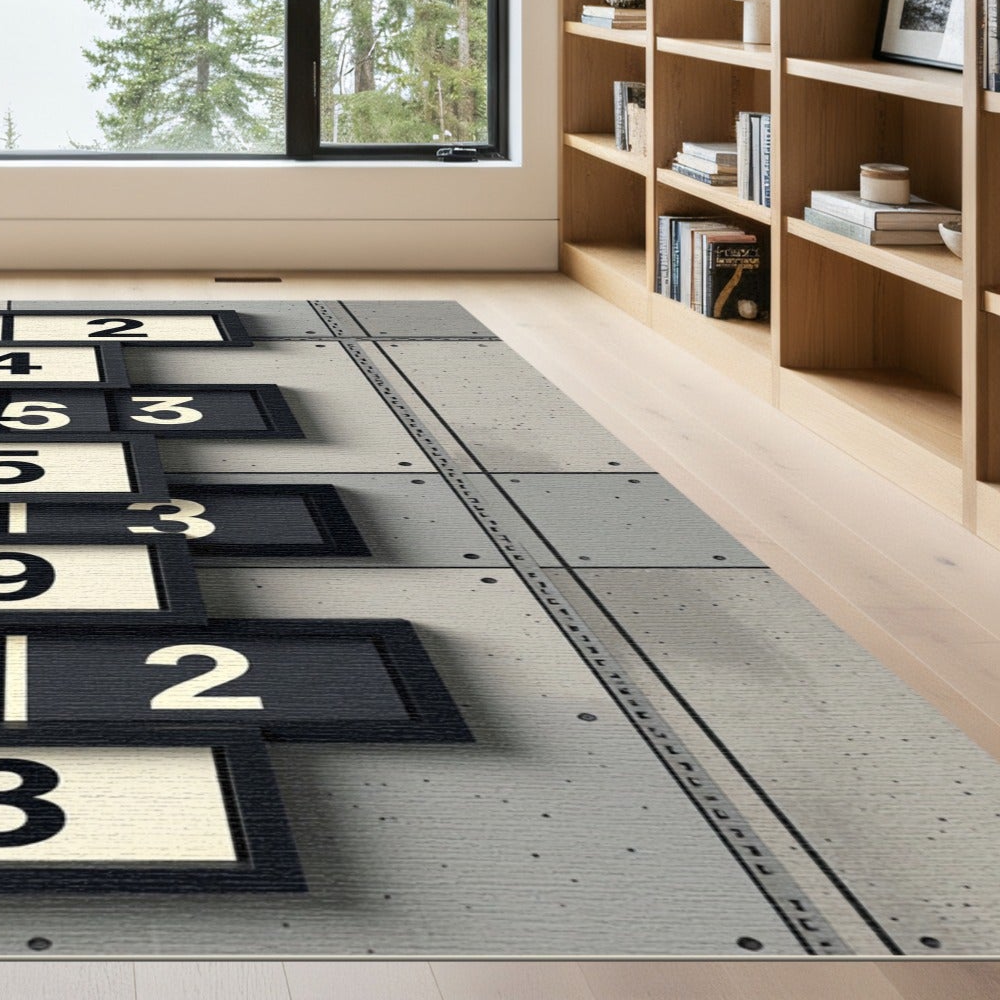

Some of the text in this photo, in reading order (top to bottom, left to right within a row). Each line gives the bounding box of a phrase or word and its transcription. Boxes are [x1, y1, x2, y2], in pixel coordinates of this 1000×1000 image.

[87, 318, 148, 337] 2
[131, 397, 203, 424] 3
[128, 499, 215, 539] 3
[145, 644, 264, 709] 2
